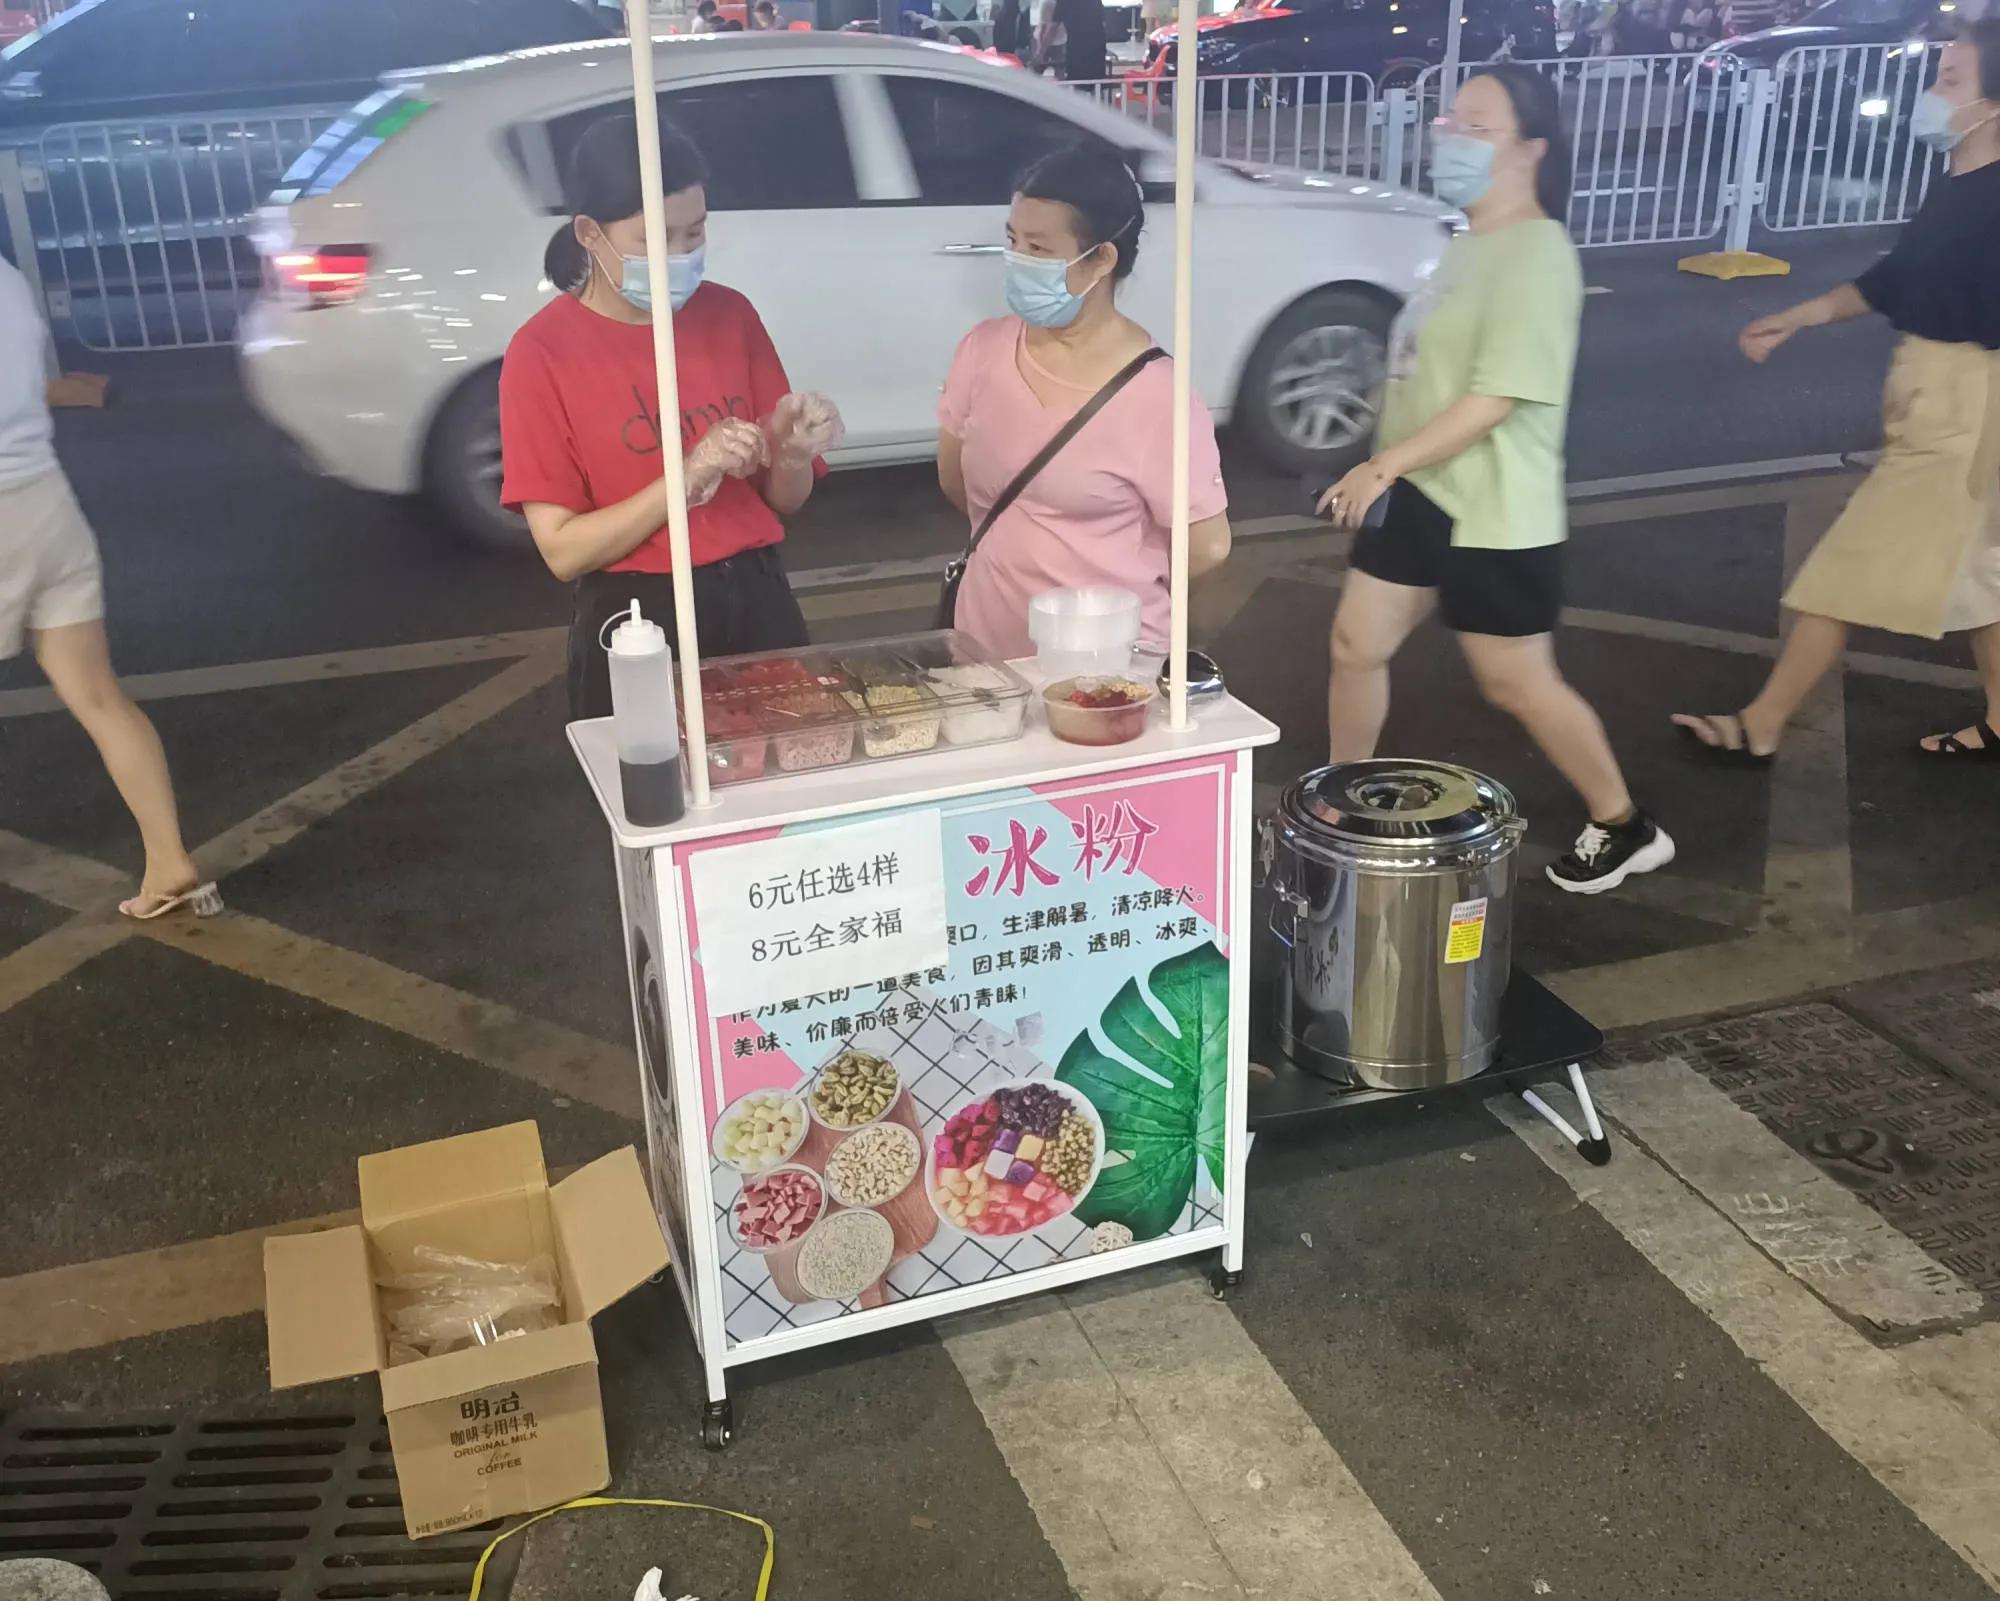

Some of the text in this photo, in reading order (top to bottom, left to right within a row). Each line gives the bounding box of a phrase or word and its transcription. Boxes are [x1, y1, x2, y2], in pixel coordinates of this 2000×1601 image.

[965, 799, 1159, 896] 冰粉
[749, 851, 900, 910] 6元任选4样
[751, 907, 902, 962] 8元全家福
[454, 1431, 538, 1459] ORIGINAL MILK
[477, 1457, 522, 1476] COFFEE
